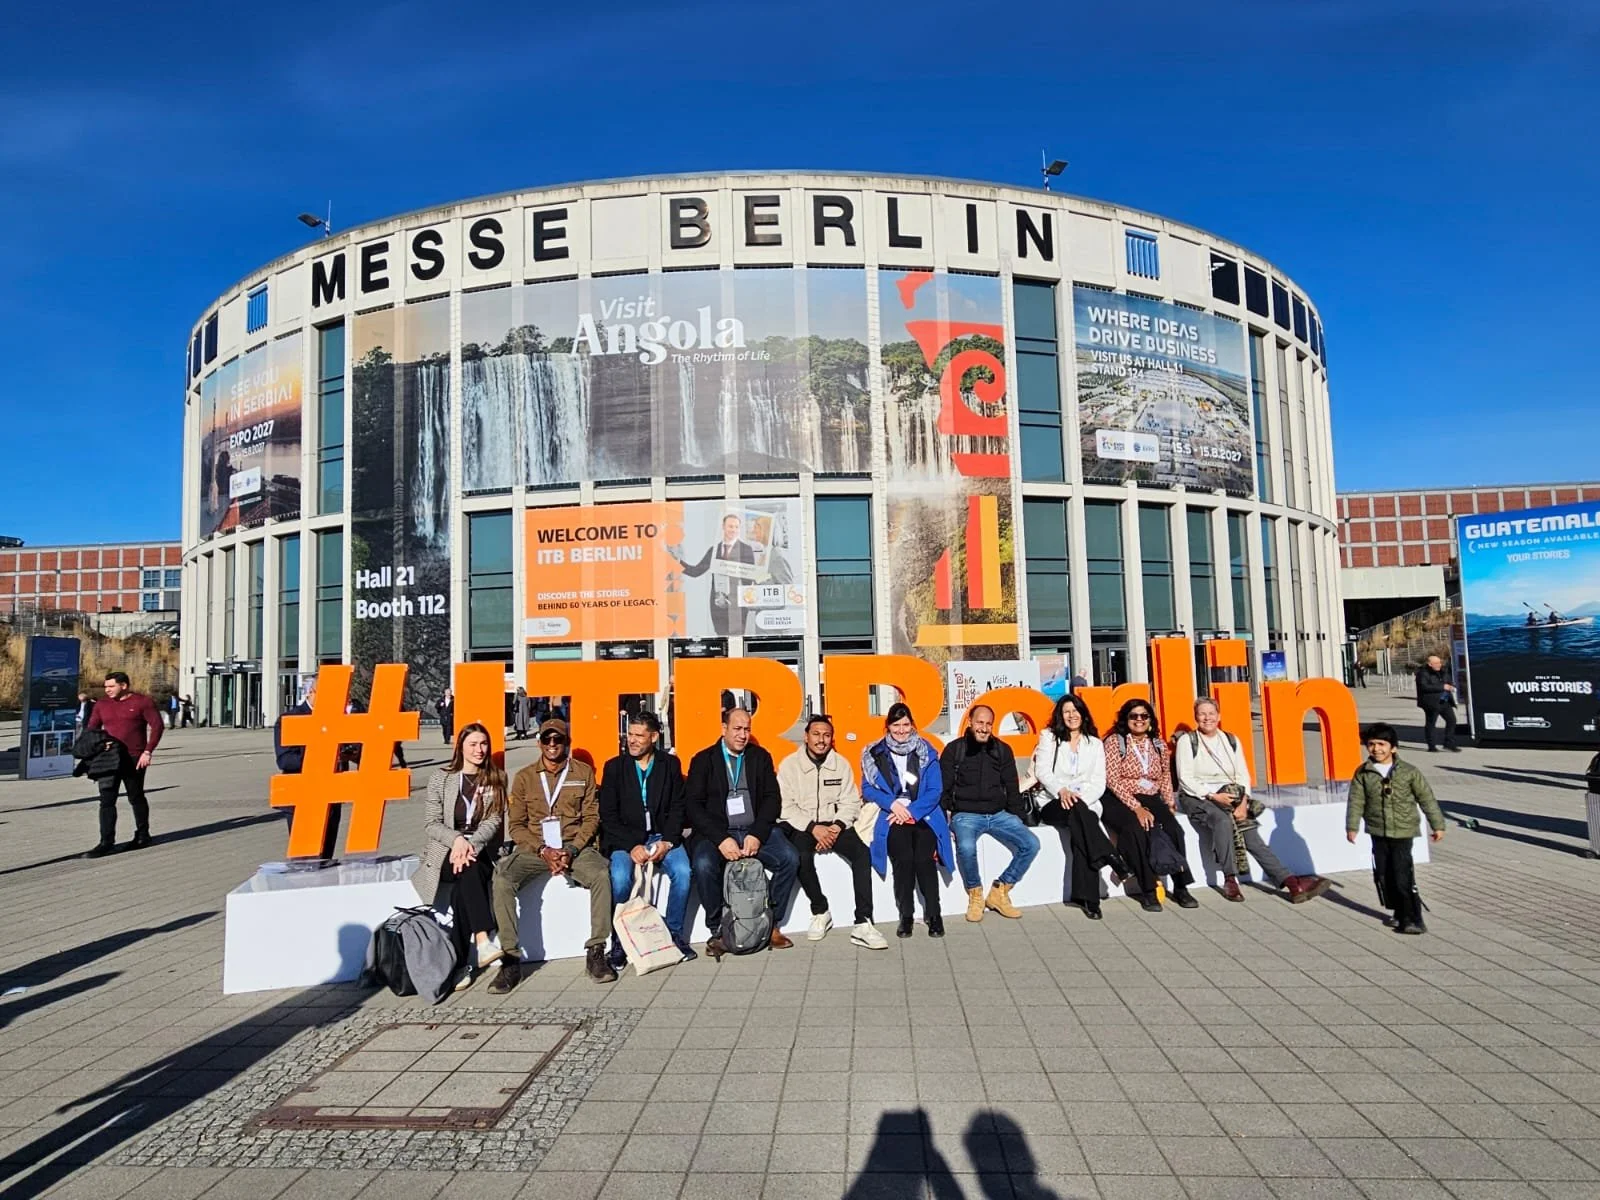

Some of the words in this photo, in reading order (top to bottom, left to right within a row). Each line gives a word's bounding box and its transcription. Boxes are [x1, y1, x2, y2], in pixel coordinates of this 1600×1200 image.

[312, 208, 569, 307] MESSE
[669, 195, 1053, 262] BERLIN
[600, 296, 656, 319] Visit
[1088, 306, 1150, 331] WHERE
[1155, 317, 1198, 341] IDEAS
[571, 305, 746, 365] Angola
[1089, 327, 1141, 350] DRIVE
[1146, 336, 1217, 364] BUSINESS
[671, 354, 690, 364] The
[693, 352, 735, 364] Rhythm
[737, 351, 749, 361] of
[751, 351, 770, 361] Life
[1091, 350, 1117, 363] VISIT
[1120, 354, 1132, 366] US
[1134, 356, 1146, 368] AT
[1148, 359, 1170, 372] HALL
[1092, 363, 1126, 377] STAND
[1128, 368, 1144, 378] 124
[231, 378, 249, 400] SEE
[253, 366, 279, 391] YOU
[230, 404, 240, 421] IN
[244, 382, 292, 415] SERBIA!
[229, 428, 251, 448] EXPO
[253, 420, 274, 440] 2027
[1200, 446, 1242, 462] 15.8.2027
[537, 525, 628, 543] WELCOME
[635, 524, 657, 538] TO
[1502, 539, 1540, 547] SEASON
[1544, 532, 1599, 543] AVAILABLE
[538, 548, 564, 564] ITB
[570, 545, 643, 563] BERLIN!
[1507, 552, 1531, 563] YOUR
[1532, 549, 1570, 560] STORIES
[356, 566, 391, 589] Hall
[396, 566, 414, 586] 21
[538, 590, 577, 600] DISCOVER
[580, 590, 594, 599] THE
[597, 589, 630, 598] STORIES
[763, 588, 779, 596] ITB
[356, 595, 413, 618] Booth
[418, 594, 445, 615] 112
[538, 601, 568, 610] BEHIND
[570, 601, 580, 609] 60
[582, 600, 608, 608] YEARS
[611, 600, 620, 608] OF
[623, 599, 658, 607] LEGACY.
[993, 675, 1007, 683] Visit
[1507, 682, 1539, 694] YOUR
[1541, 682, 1592, 694] STORIES
